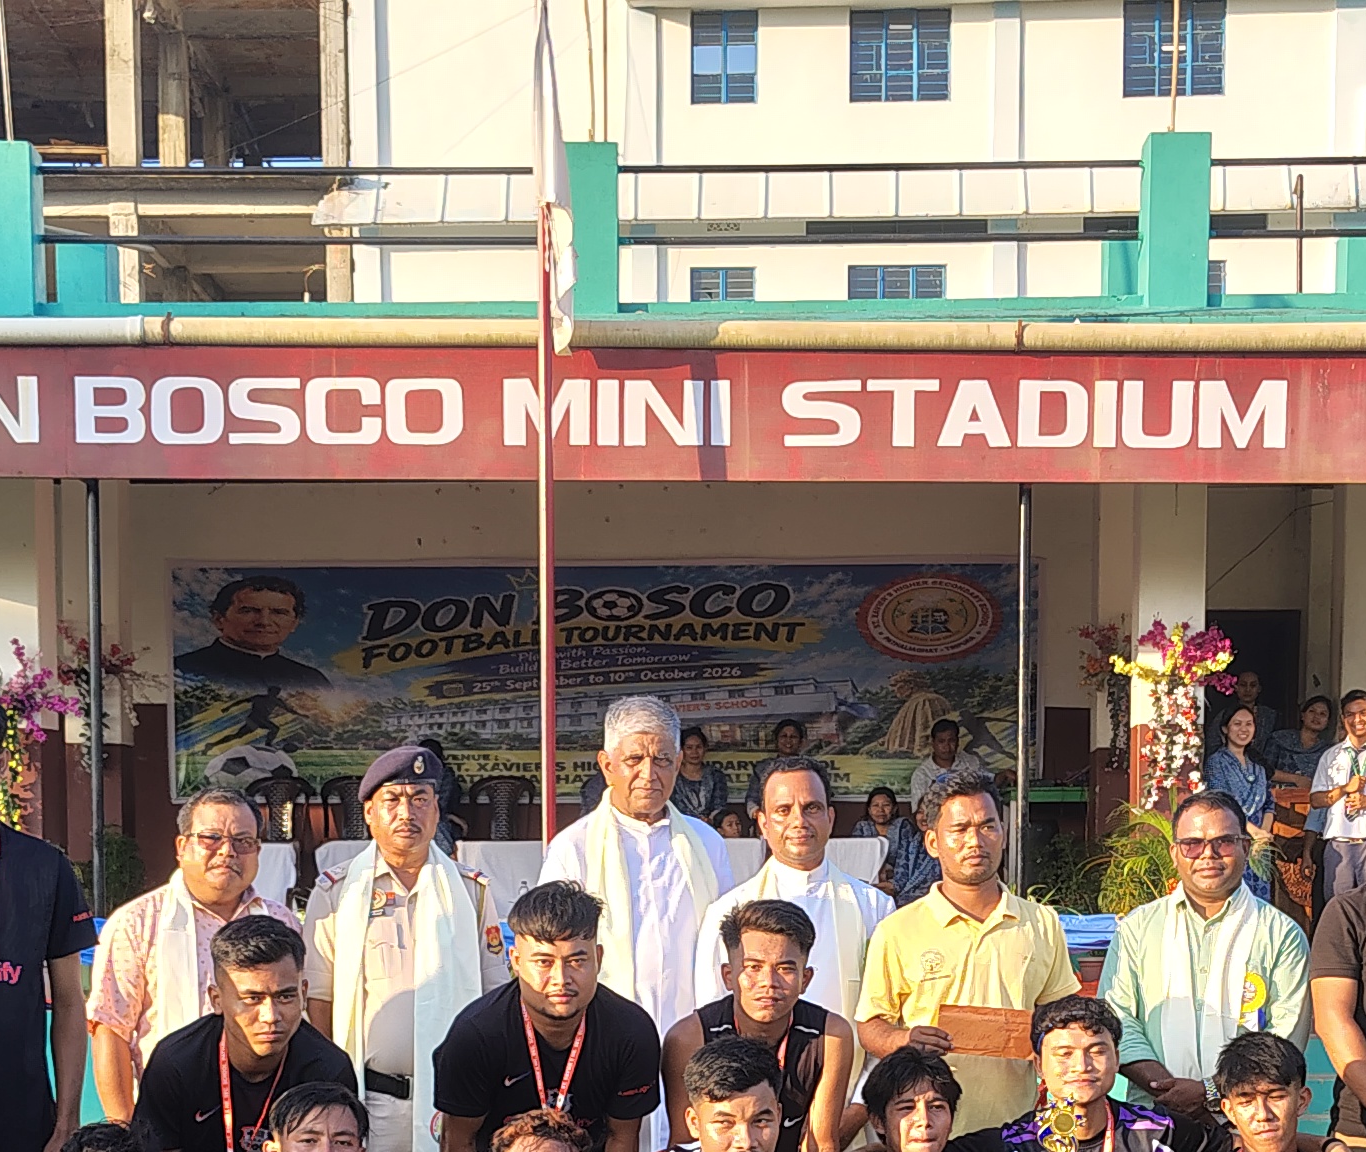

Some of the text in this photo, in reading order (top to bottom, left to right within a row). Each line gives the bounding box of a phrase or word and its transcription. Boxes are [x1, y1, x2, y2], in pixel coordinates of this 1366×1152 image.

[74, 375, 463, 446] BOSCO
[502, 377, 732, 448] MINI
[781, 377, 1288, 449] STADIUM
[361, 591, 517, 642] DON
[361, 621, 806, 670] FOOTBALL TOURNAMENT
[560, 657, 608, 671] Better
[588, 674, 604, 685] to
[640, 668, 698, 682] October
[703, 666, 742, 679] 2026
[715, 698, 768, 710] SCHOOL
